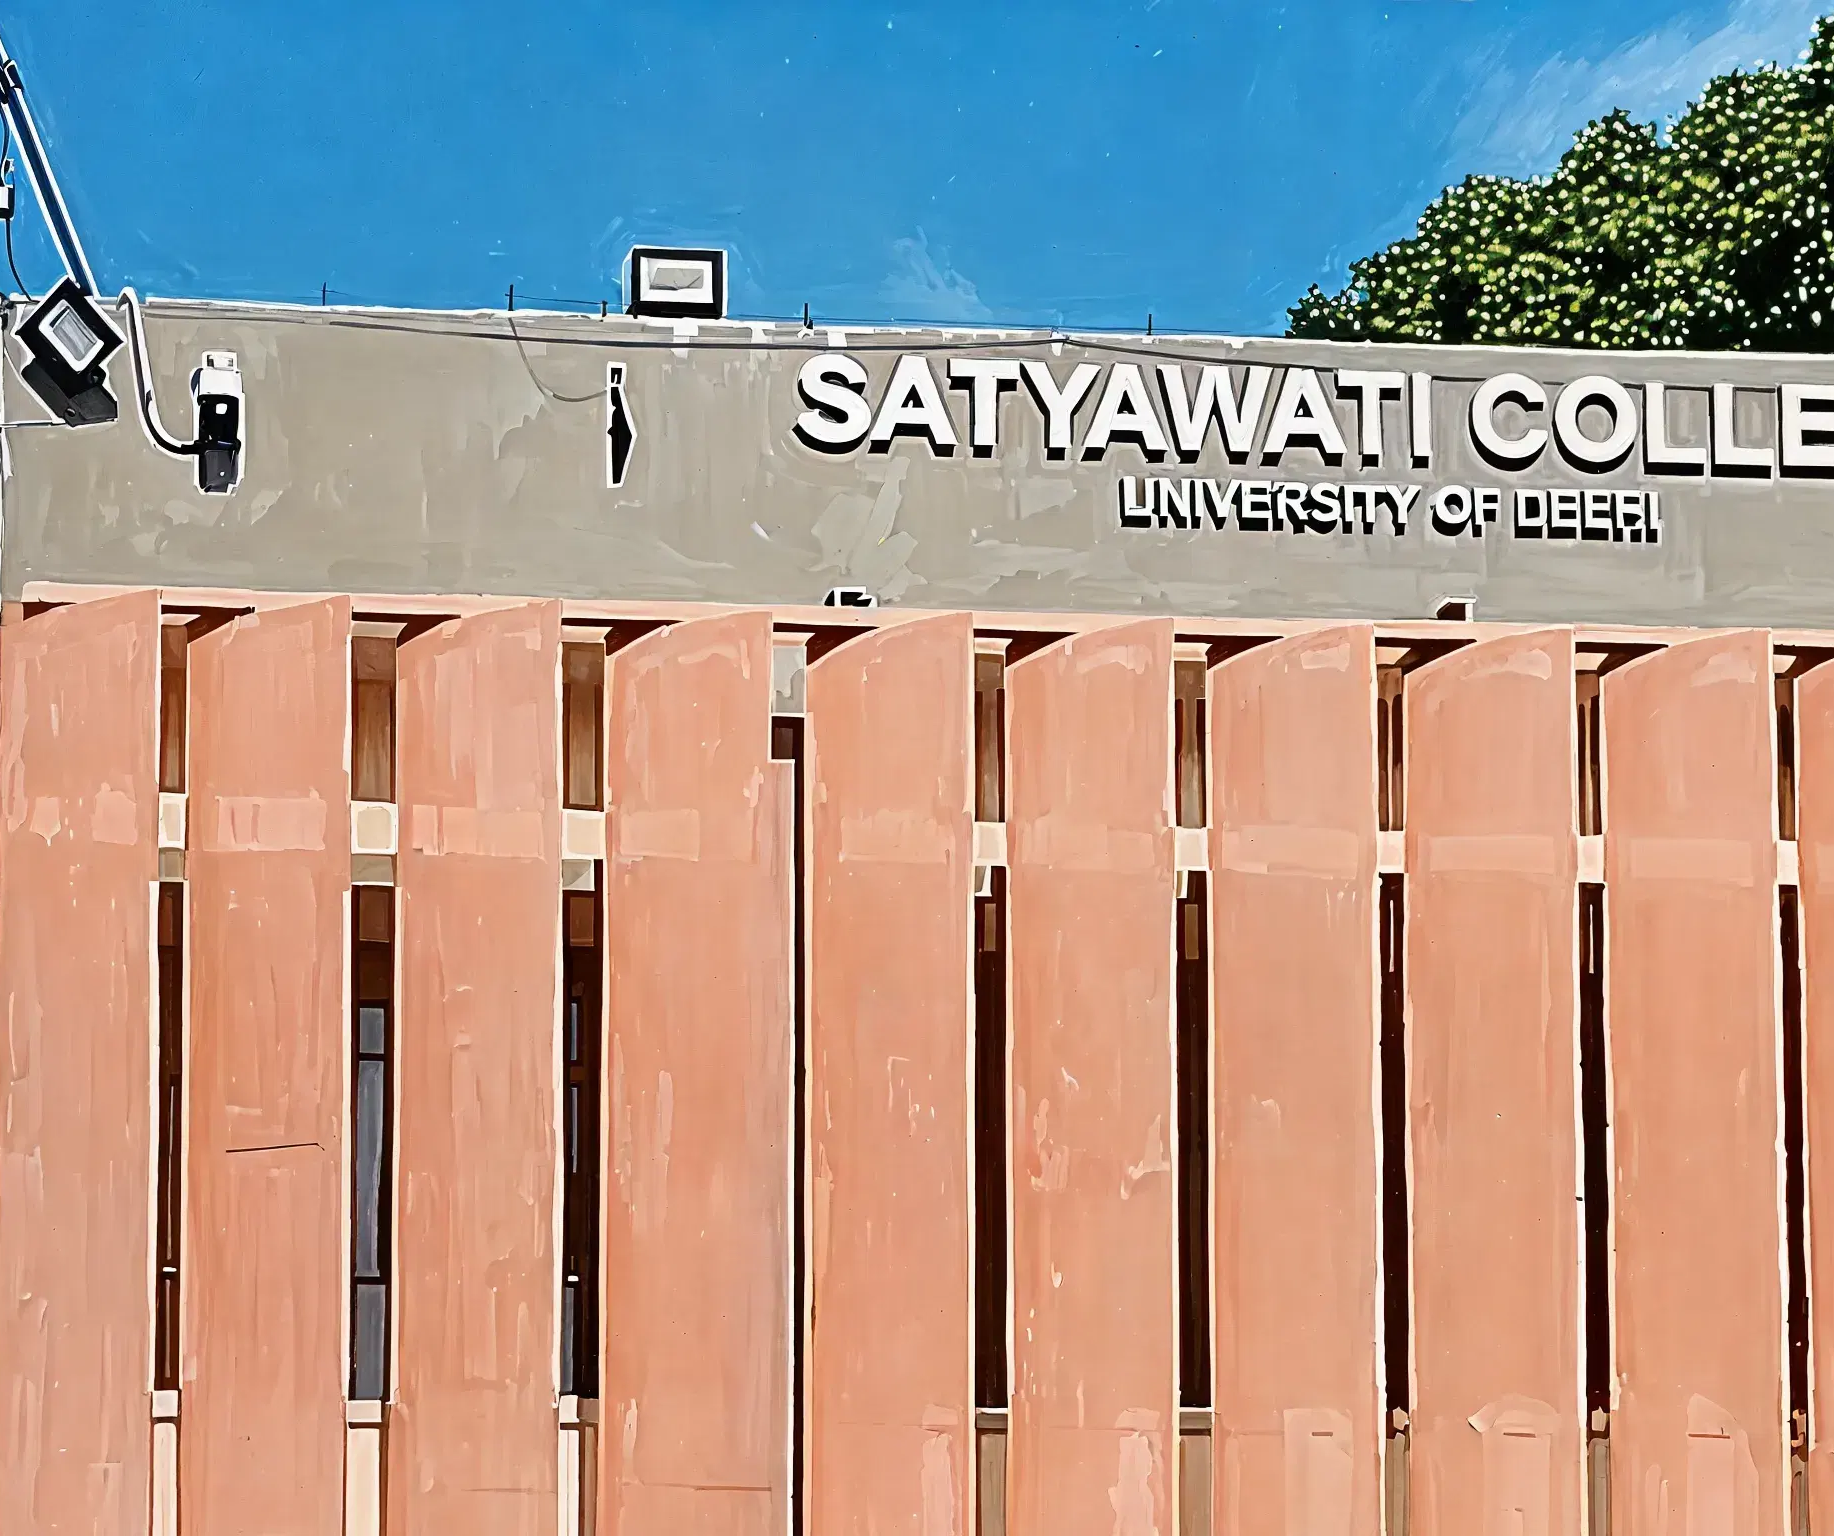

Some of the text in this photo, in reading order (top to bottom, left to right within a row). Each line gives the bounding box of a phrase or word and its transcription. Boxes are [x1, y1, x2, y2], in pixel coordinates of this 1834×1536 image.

[792, 354, 1433, 467] SATYAWATI
[1120, 476, 1422, 535] UNIVERSITY
[1432, 485, 1500, 538] OF
